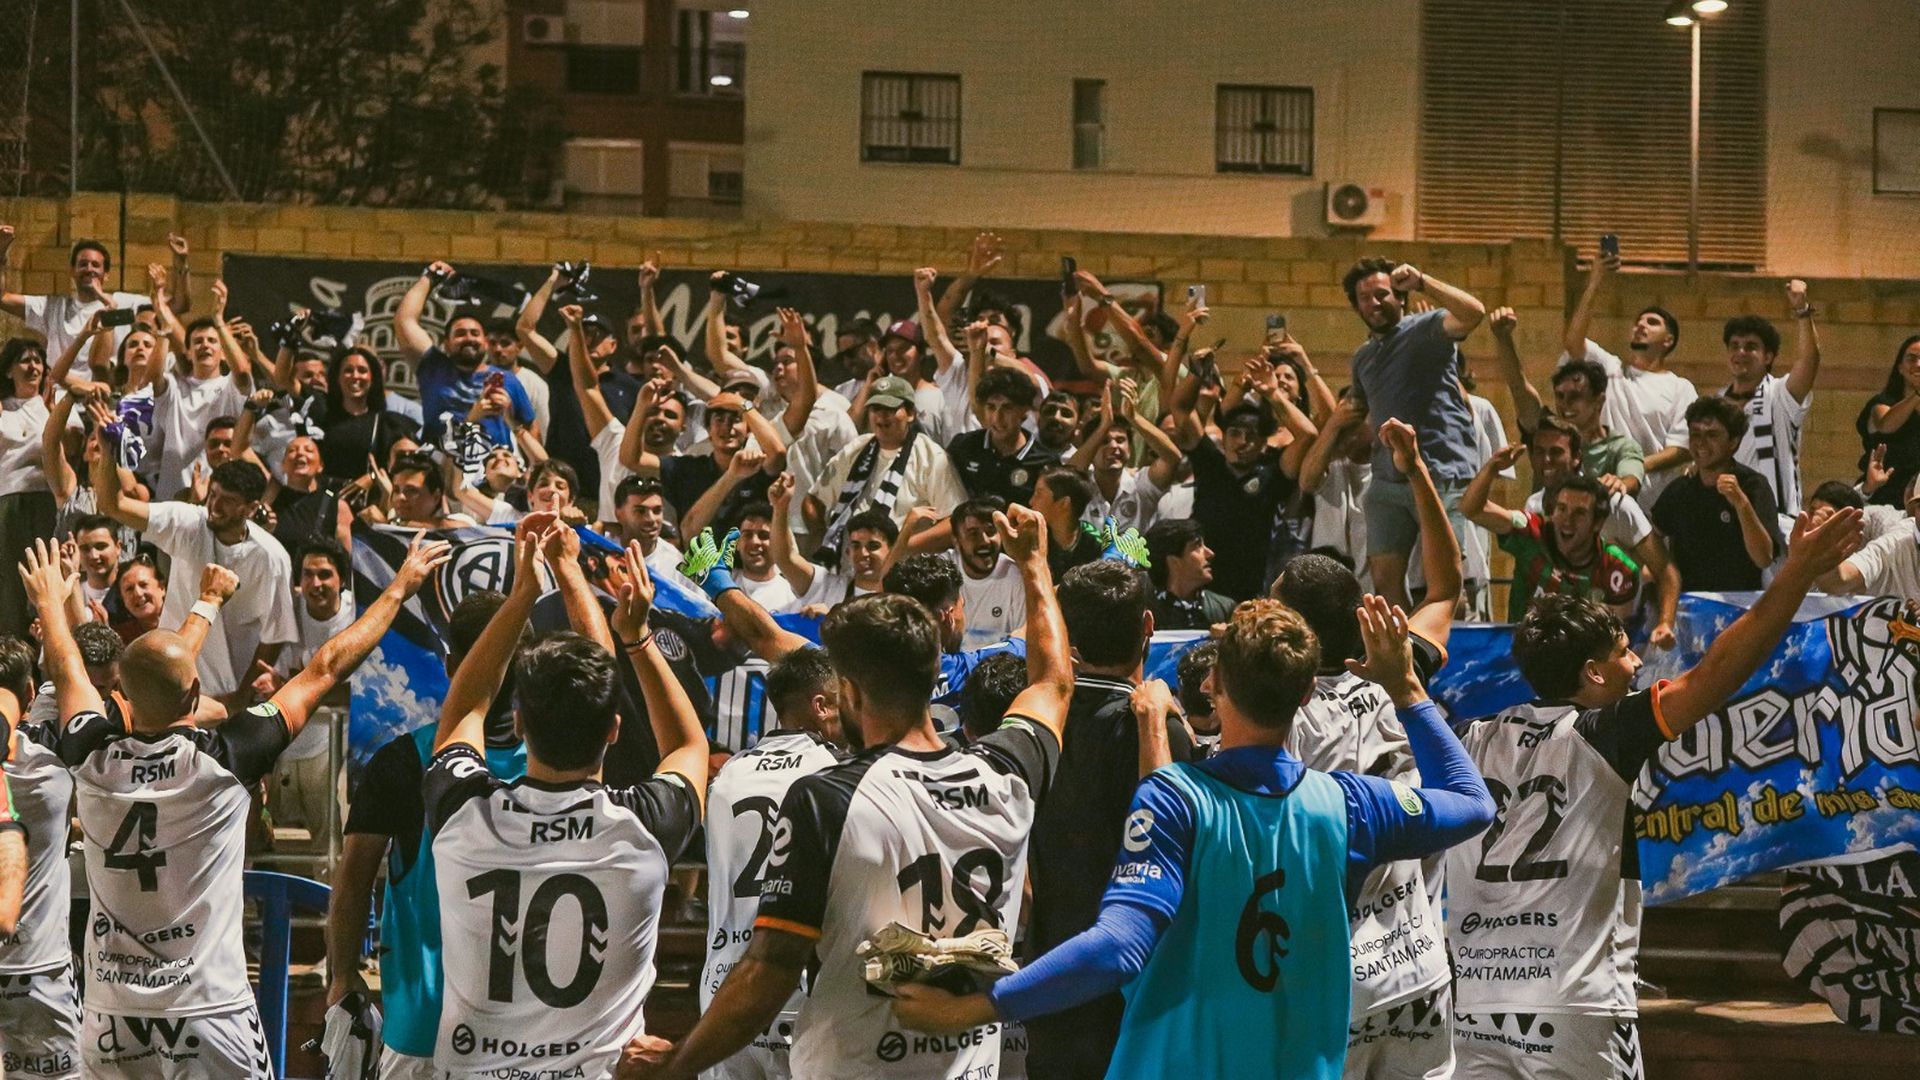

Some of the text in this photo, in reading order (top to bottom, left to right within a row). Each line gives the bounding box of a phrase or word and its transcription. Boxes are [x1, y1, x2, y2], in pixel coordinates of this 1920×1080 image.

[131, 759, 176, 784] RSM
[756, 754, 802, 772] RSM
[929, 783, 989, 811] RSM
[1753, 784, 1803, 824] de
[1815, 787, 1878, 816] mis
[531, 816, 594, 844] RSM
[1475, 774, 1568, 882] 22
[104, 801, 167, 892] 4
[1236, 869, 1290, 993] 6
[1480, 912, 1559, 929] HOLGERS
[466, 869, 608, 1009] 10
